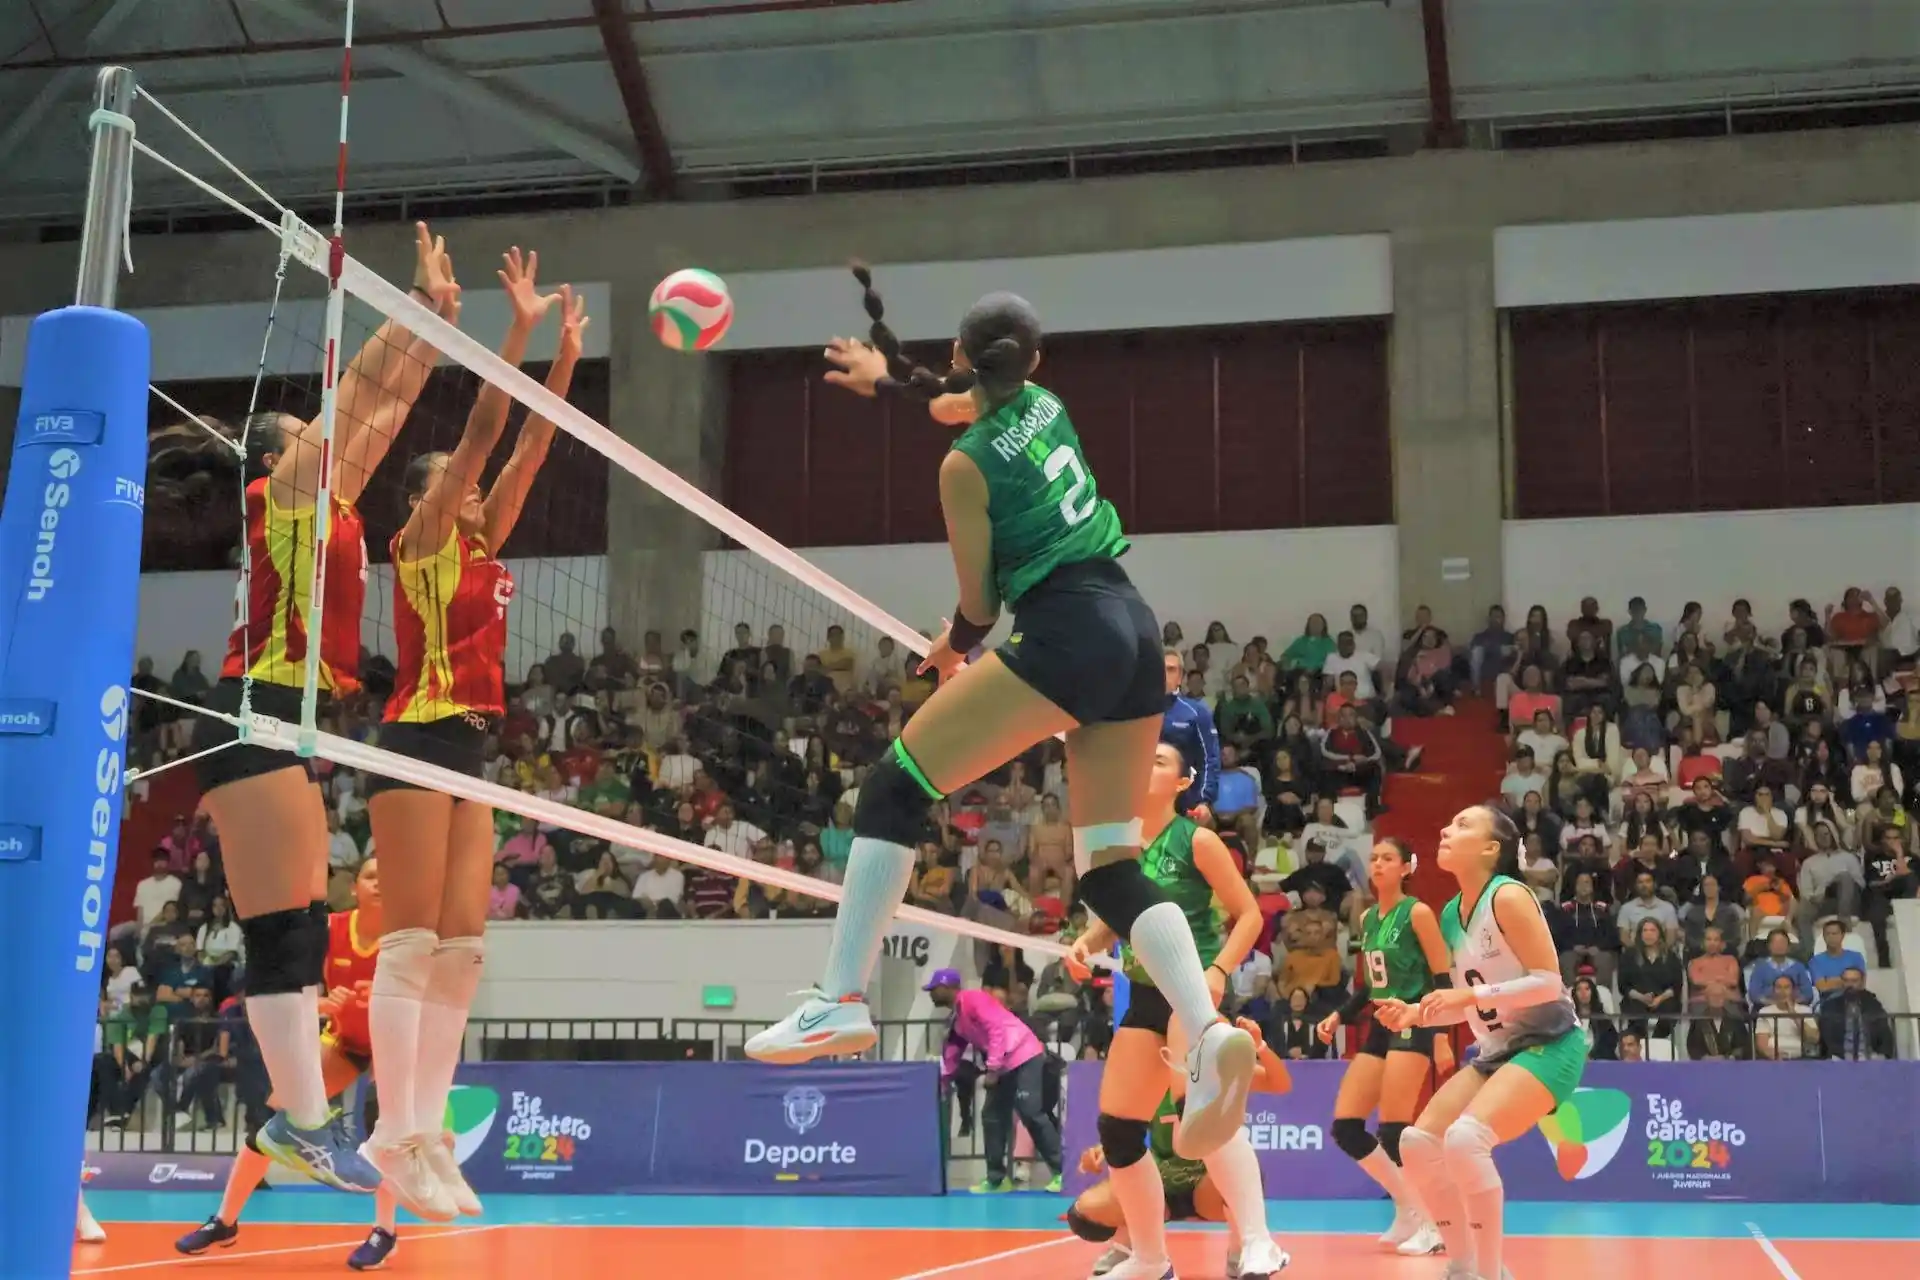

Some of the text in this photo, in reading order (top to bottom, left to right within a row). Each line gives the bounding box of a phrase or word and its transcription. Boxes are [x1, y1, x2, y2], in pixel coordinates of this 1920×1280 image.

[1043, 444, 1097, 526] 2
[27, 483, 70, 600] Senoh
[0, 711, 40, 725] noh
[75, 748, 119, 973] Senoh
[1364, 950, 1388, 988] 19
[511, 1091, 542, 1118] Eje
[1256, 1110, 1276, 1124] de
[1646, 1093, 1683, 1122] Eje
[503, 1135, 576, 1161] 2024
[1250, 1124, 1323, 1150] EIRA
[744, 1138, 857, 1168] Deporte
[1647, 1141, 1731, 1169] 2024
